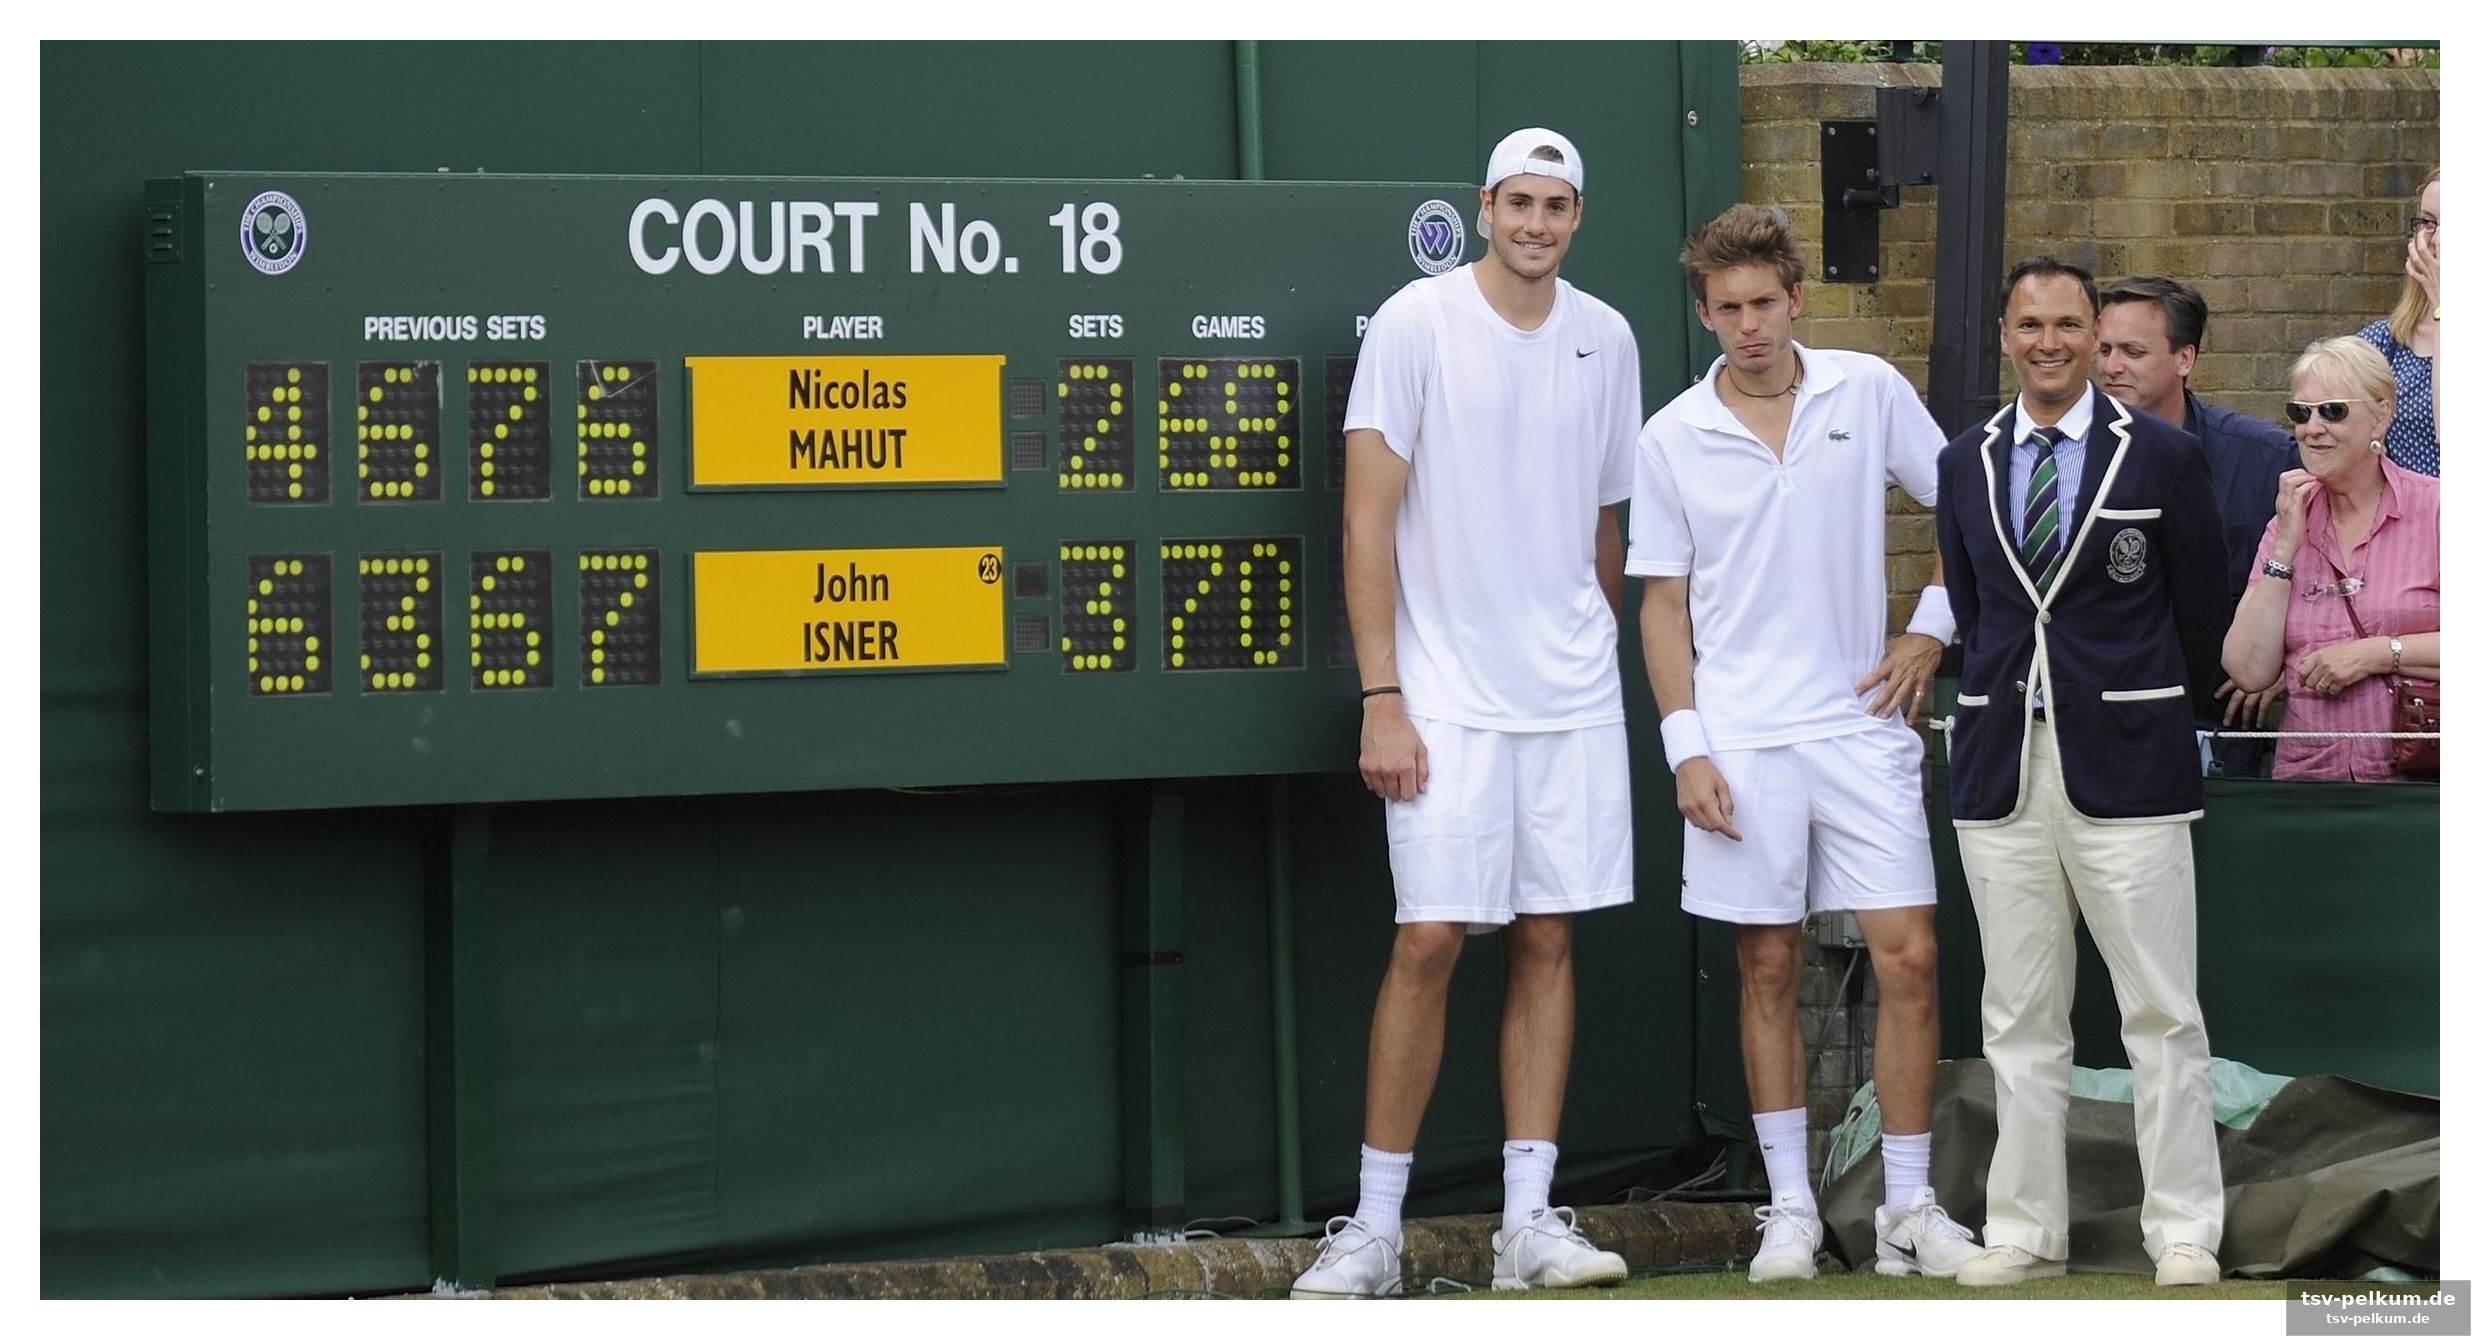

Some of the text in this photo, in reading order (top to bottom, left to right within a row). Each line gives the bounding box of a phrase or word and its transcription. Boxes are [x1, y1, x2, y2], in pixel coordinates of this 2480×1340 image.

[250, 194, 303, 234] CHAMPIONSHIPS
[1417, 202, 1461, 239] CHAMPIONSHIPS
[628, 197, 1123, 276] COURT No. 18
[249, 250, 297, 271] WIMBLEDON
[1416, 253, 1457, 273] WIMBLEDON
[364, 314, 546, 341] PREVIOUS SETS
[803, 315, 884, 339] PLAYER
[1068, 313, 1125, 339] SETS
[1191, 314, 1266, 340] GAMES
[788, 368, 908, 410] Nicolas
[246, 366, 646, 498] 4 6 7 6
[1058, 364, 1123, 488] 2
[1158, 363, 1290, 488] 68
[788, 429, 908, 470] MAHUT
[812, 561, 890, 604] John
[981, 556, 998, 581] 23
[248, 554, 647, 691] 6 3 6 7
[1060, 545, 1126, 670] 3
[1161, 543, 1291, 667] 70
[803, 619, 900, 663] ISNER
